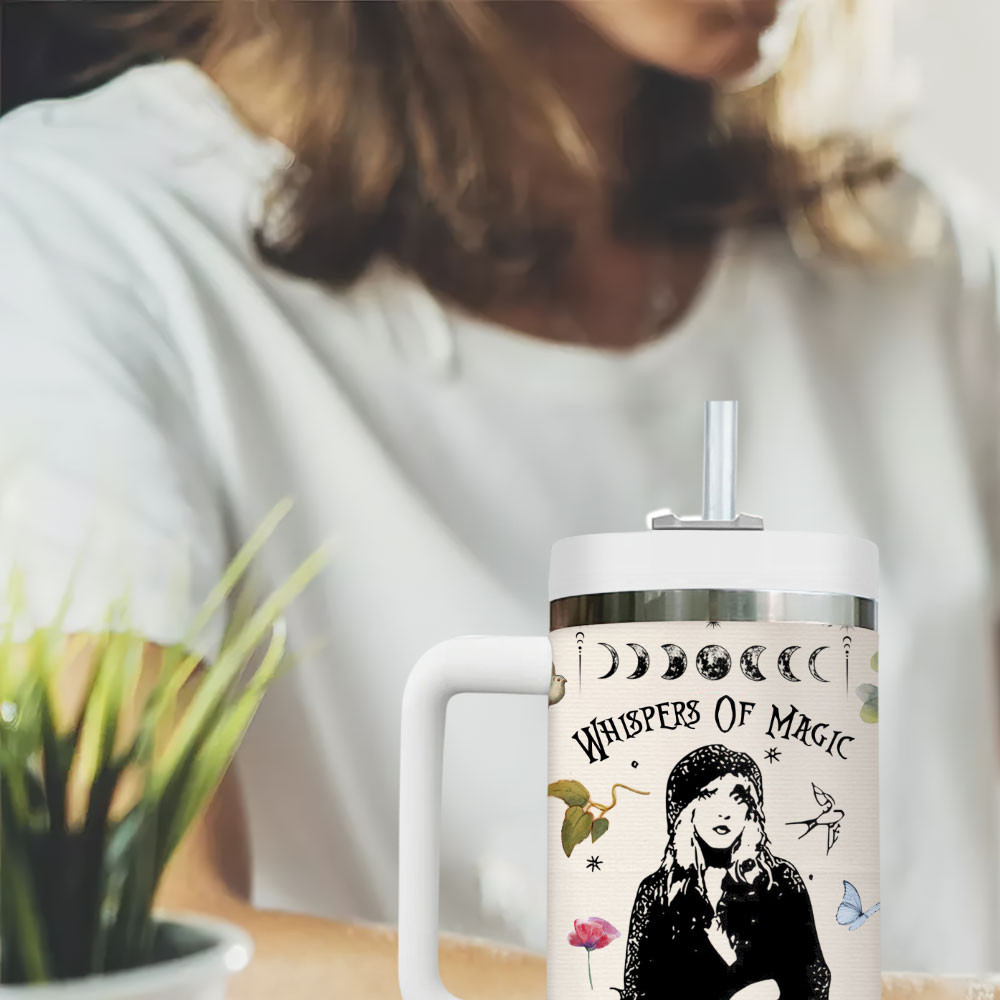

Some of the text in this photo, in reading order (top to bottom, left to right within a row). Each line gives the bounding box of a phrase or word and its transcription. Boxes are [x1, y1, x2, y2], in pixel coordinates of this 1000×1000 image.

[571, 694, 856, 765] WHISPERS OF MAGIC
